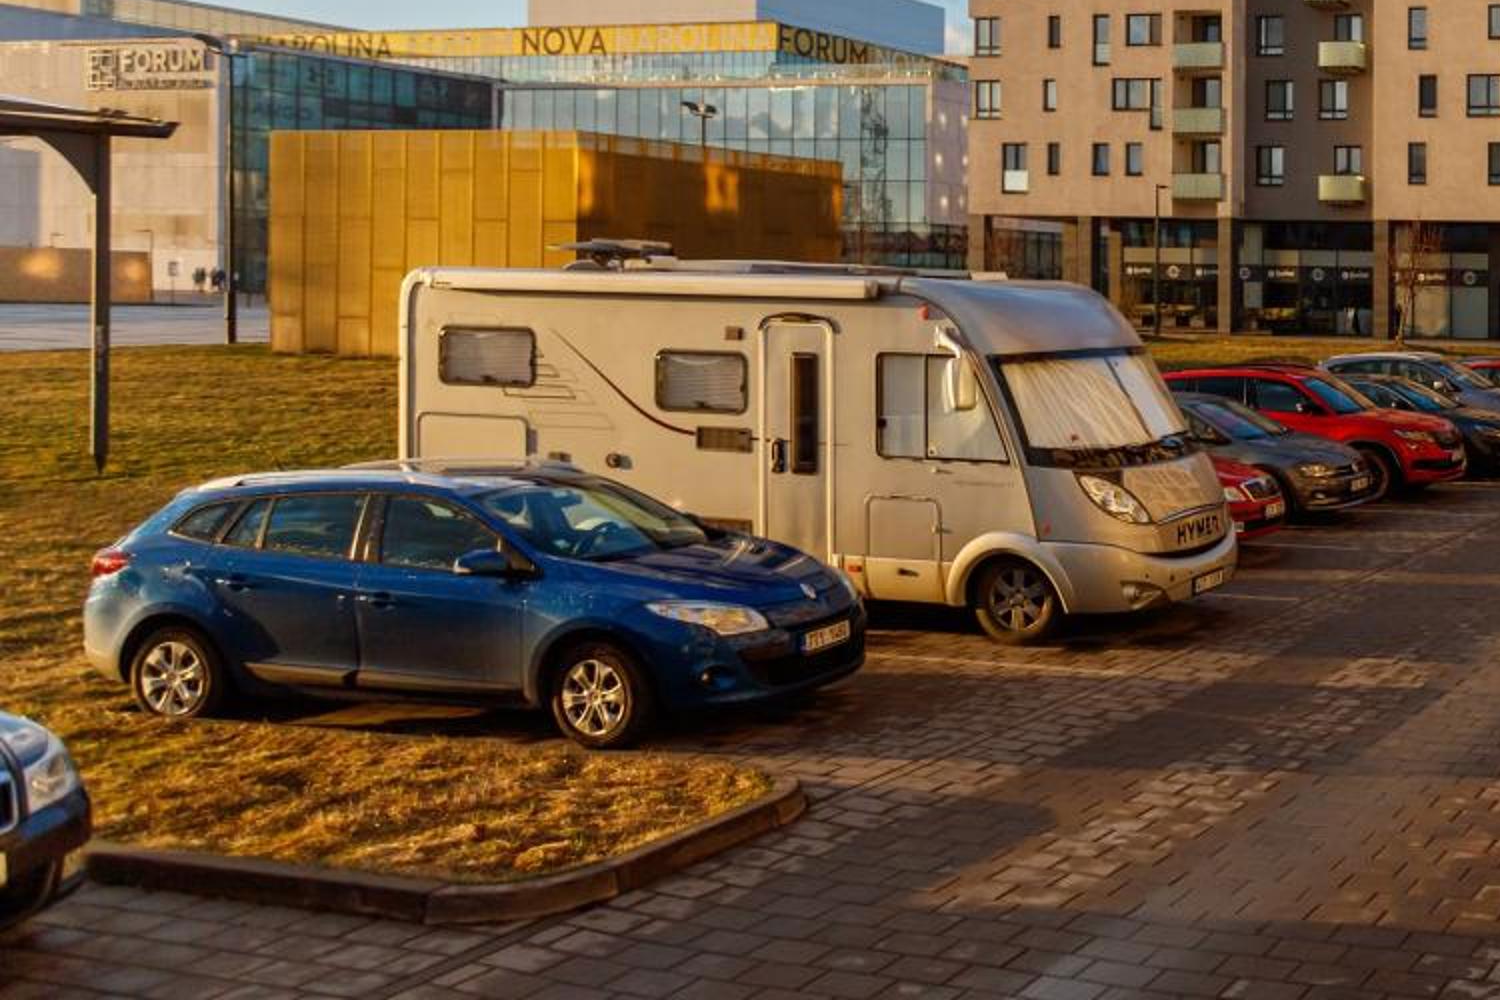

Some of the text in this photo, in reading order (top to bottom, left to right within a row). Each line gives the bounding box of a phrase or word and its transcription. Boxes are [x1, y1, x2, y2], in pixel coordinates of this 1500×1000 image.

[520, 28, 607, 56] NOVA
[778, 23, 869, 65] FORUM
[119, 49, 204, 72] FORUM
